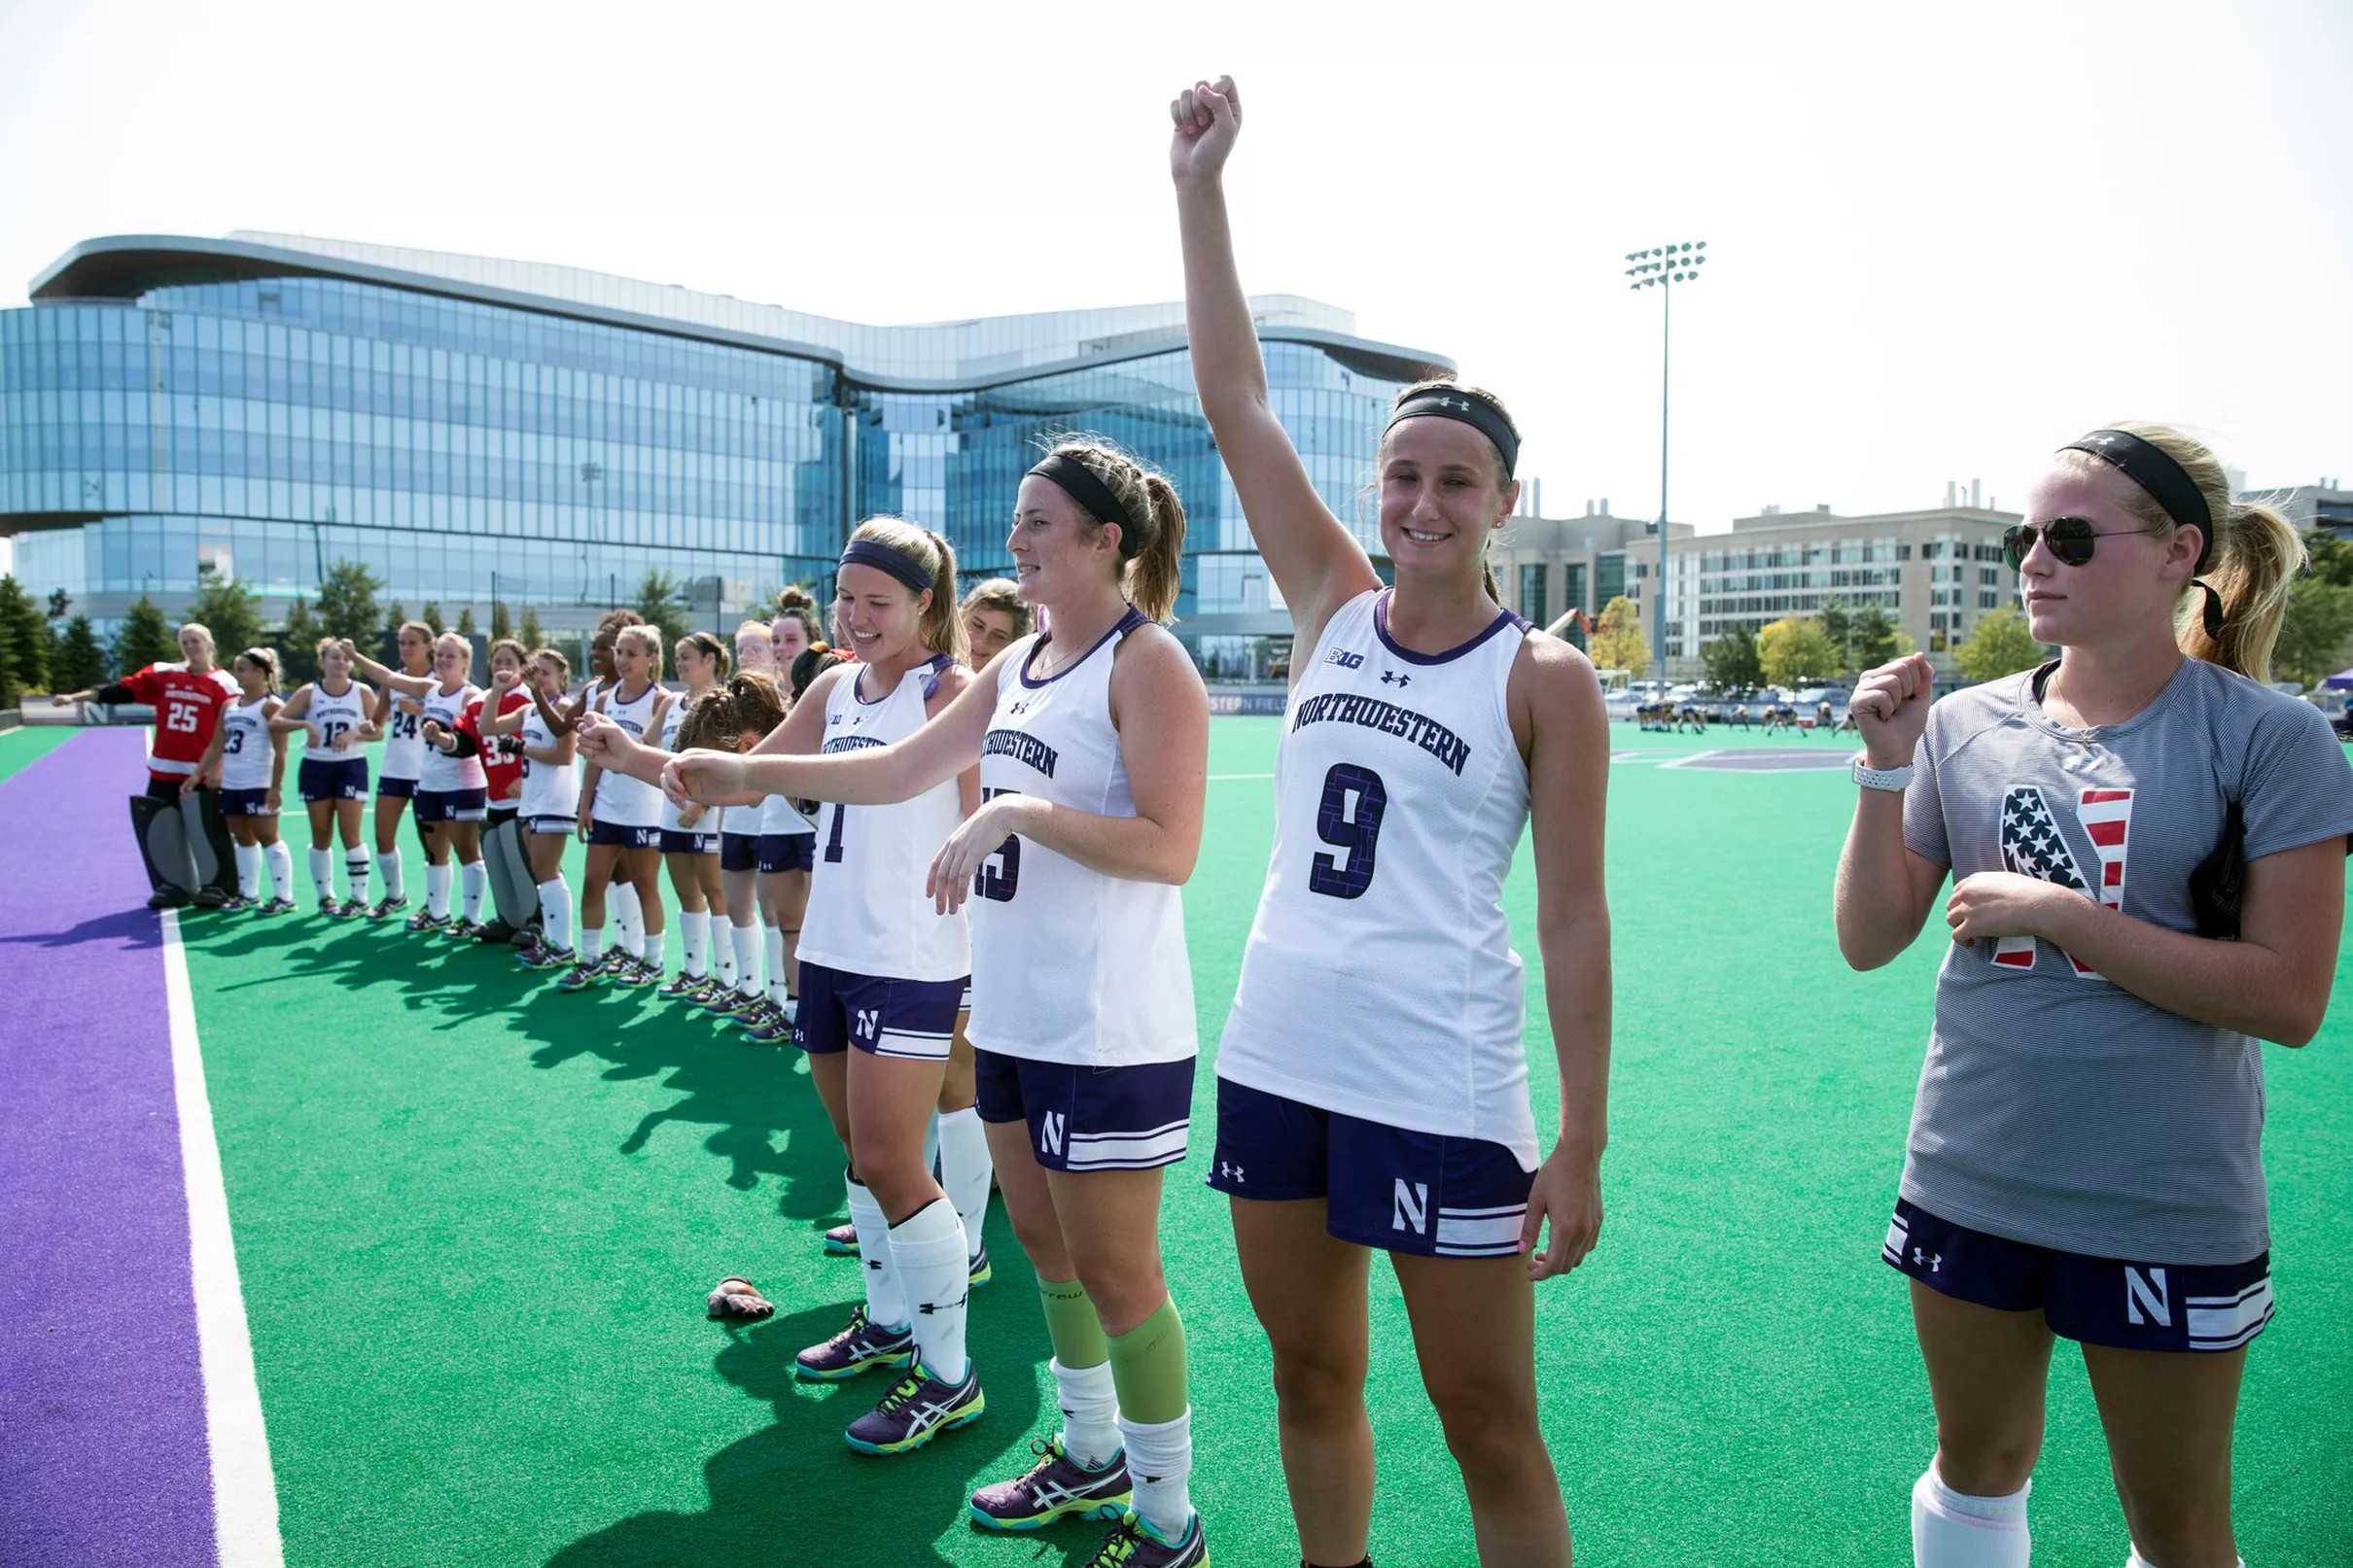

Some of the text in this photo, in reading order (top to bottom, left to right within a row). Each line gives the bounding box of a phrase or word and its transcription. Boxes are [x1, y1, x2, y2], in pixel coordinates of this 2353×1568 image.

[166, 702, 199, 733] 25
[393, 712, 417, 739] 24
[1291, 693, 1471, 778] NORTHWESTERN
[637, 828, 649, 845] N
[1309, 762, 1387, 900] 9
[856, 1009, 878, 1040] N
[1041, 1110, 1066, 1156] N
[1392, 1177, 1428, 1235] N
[2125, 1266, 2172, 1327] N
